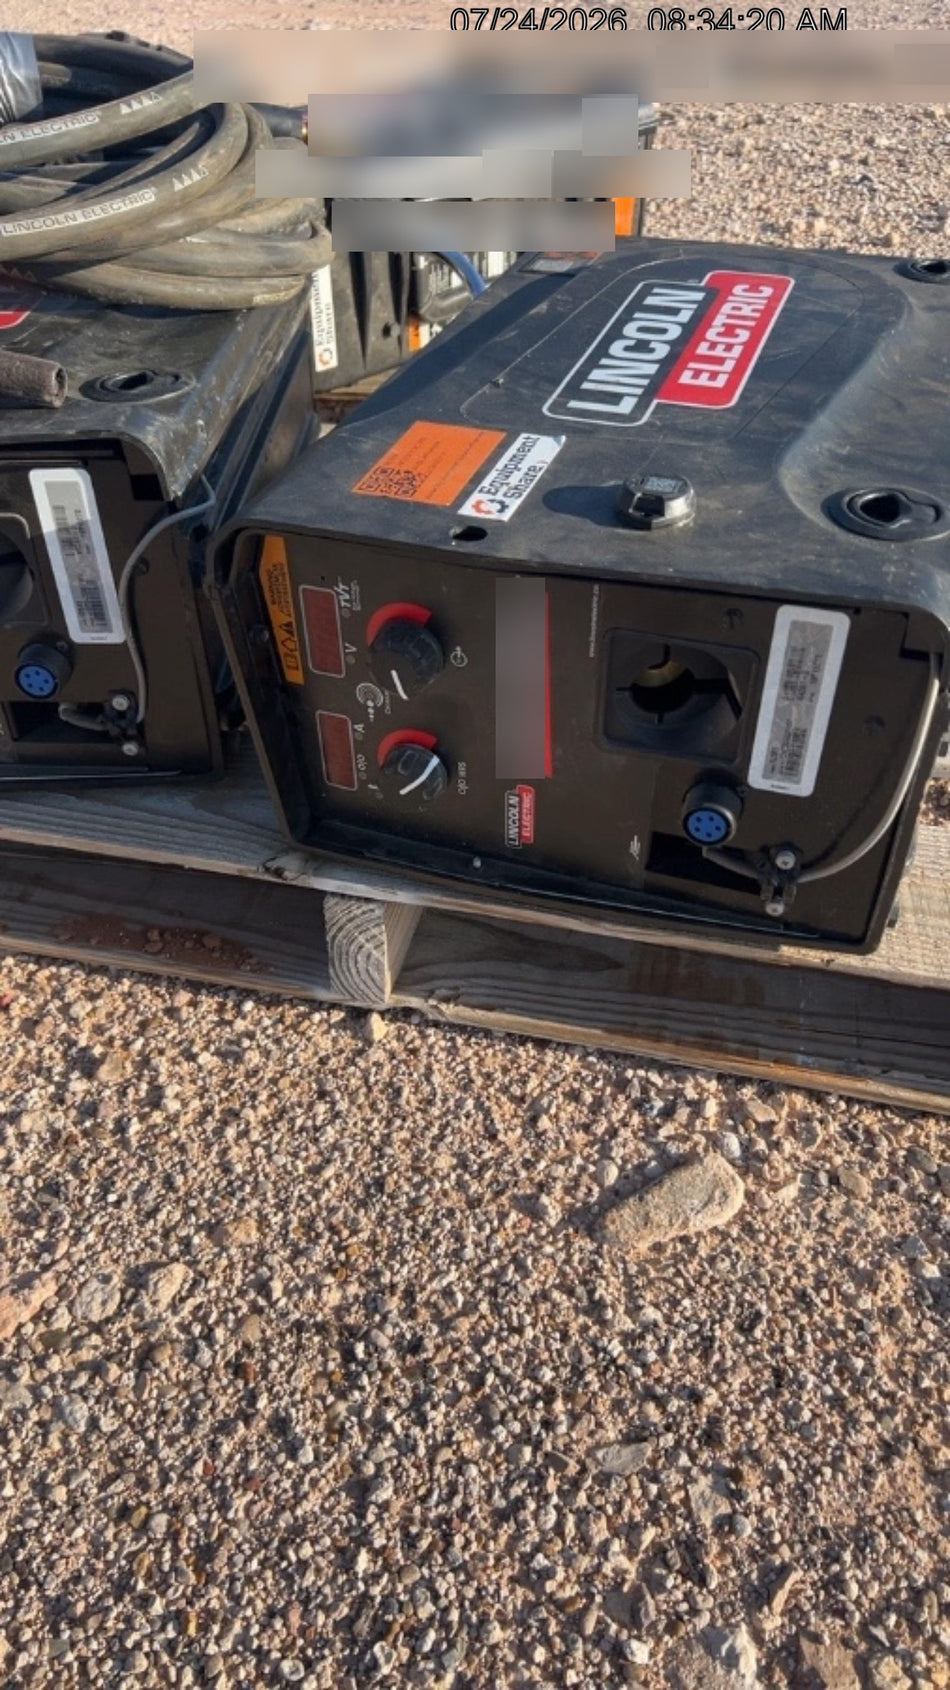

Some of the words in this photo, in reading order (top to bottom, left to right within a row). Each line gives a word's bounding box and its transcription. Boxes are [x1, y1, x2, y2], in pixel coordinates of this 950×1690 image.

[20, 112, 97, 137] ELECTRIC
[2, 213, 78, 234] LINCOLN
[82, 190, 153, 220] ELECTRIC
[567, 286, 707, 415] LINCOLN
[677, 283, 774, 389] ELECTRIC
[479, 435, 540, 497] Equipment
[503, 464, 543, 500] Share
[507, 795, 520, 846] LINCOLN
